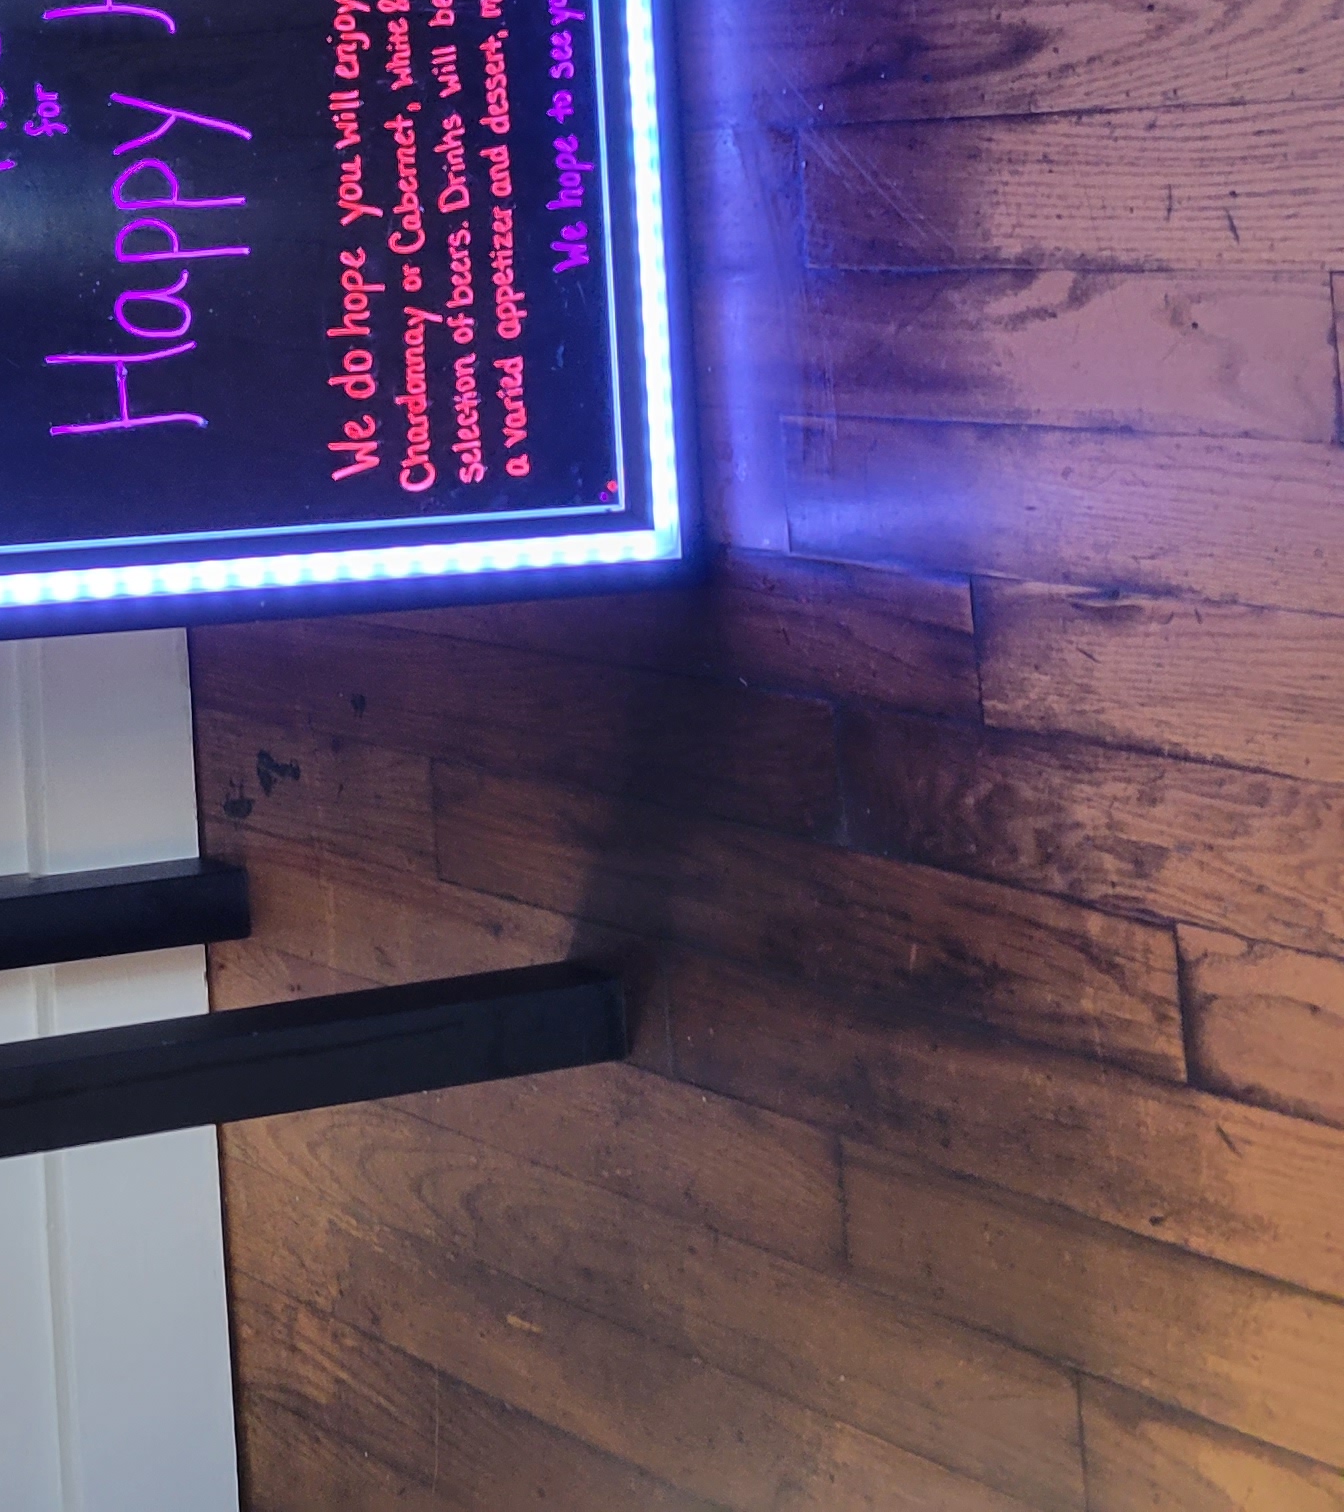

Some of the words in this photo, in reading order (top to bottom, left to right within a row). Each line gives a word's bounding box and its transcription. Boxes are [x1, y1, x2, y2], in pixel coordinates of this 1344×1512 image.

[430, 44, 462, 99] will
[477, 28, 512, 135] dessert,
[548, 29, 575, 79] see
[23, 82, 68, 138] for
[327, 89, 362, 150] will
[545, 89, 574, 124] to
[336, 153, 384, 226] you
[384, 100, 427, 255] Cabernet,
[433, 113, 471, 213] Drinks
[478, 143, 513, 198] and
[545, 133, 595, 210] hope
[43, 91, 253, 436] Happy
[400, 263, 423, 292] or
[445, 219, 475, 309] beers.
[487, 204, 528, 340] appetizer
[549, 220, 591, 273] We
[325, 246, 386, 338] hope
[445, 312, 475, 345] of
[326, 348, 377, 399] do
[394, 306, 443, 492] Chardonnay
[491, 354, 528, 449] varied
[326, 415, 381, 481] We
[449, 352, 486, 483] selection
[503, 453, 530, 478] a
